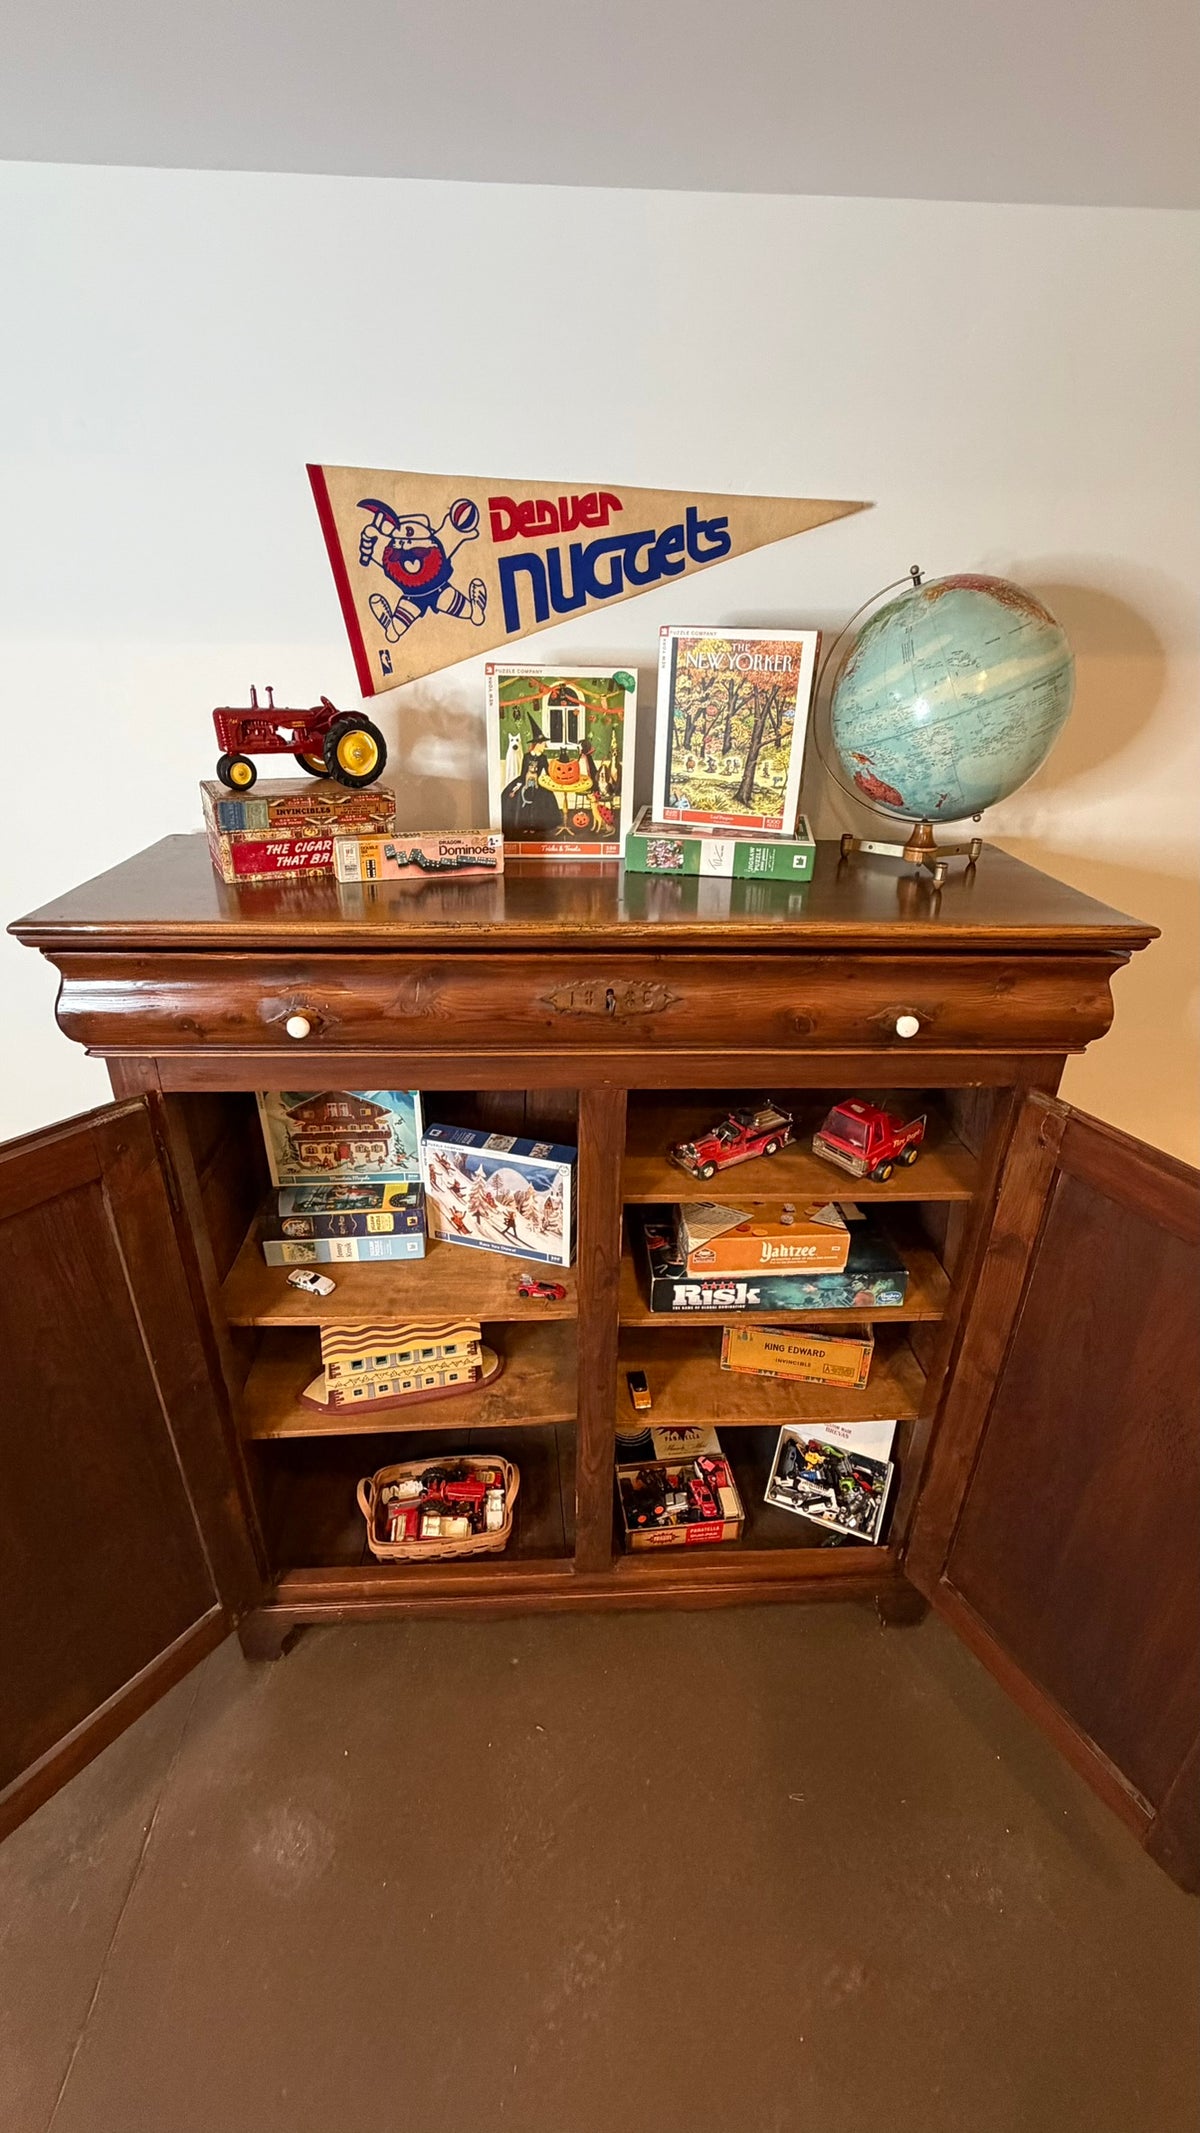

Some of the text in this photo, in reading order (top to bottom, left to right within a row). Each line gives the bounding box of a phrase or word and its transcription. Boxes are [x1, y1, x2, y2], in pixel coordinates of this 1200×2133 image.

[488, 492, 623, 543] Denver
[732, 643, 750, 652] THE
[686, 652, 792, 672] NEW YORKER
[276, 807, 330, 816] INVINCIBLES
[266, 844, 290, 856] THE
[294, 840, 332, 853] CIGAR
[439, 844, 496, 856] Dominoes
[276, 854, 309, 867] THAT
[760, 1242, 816, 1262] Yahtzee
[764, 1342, 826, 1358] KING EDWARD
[776, 1358, 811, 1368] INVINCIBLE
